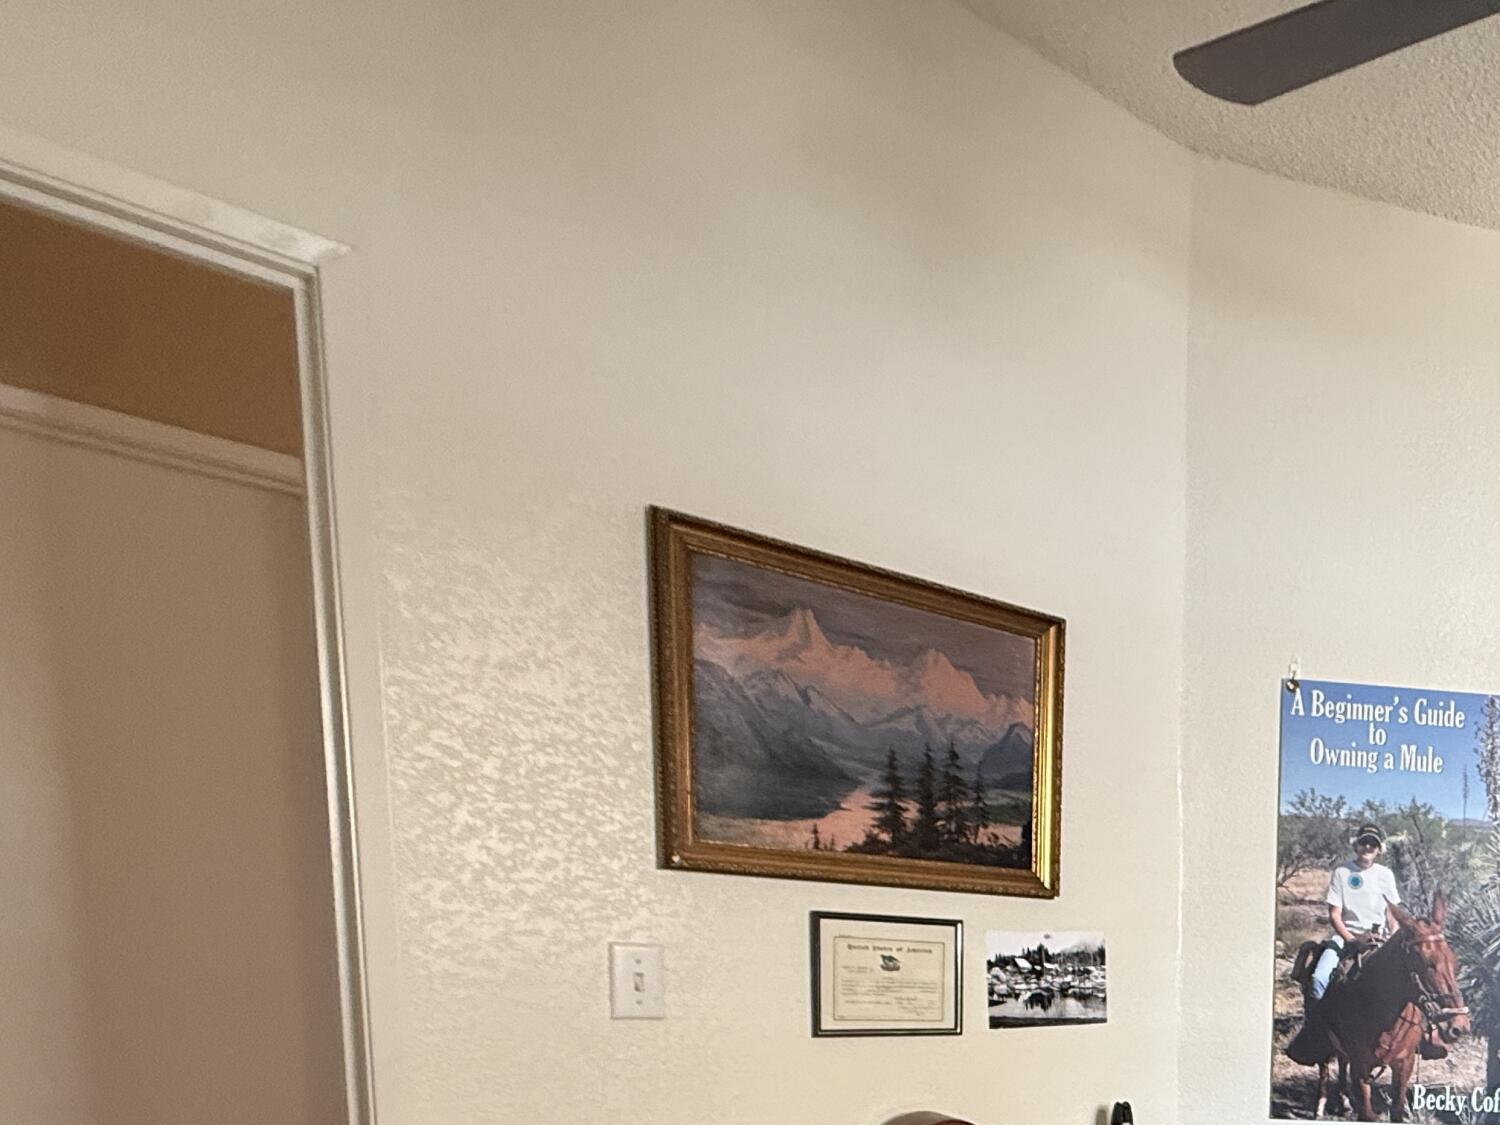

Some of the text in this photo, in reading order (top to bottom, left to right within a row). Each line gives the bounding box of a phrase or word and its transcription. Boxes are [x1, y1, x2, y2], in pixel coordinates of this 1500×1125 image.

[1290, 688, 1466, 728] A Beginner's Guide
[1368, 722, 1387, 746] to
[1309, 738, 1444, 773] Owning a Mule
[1412, 1083, 1467, 1116] Becky
